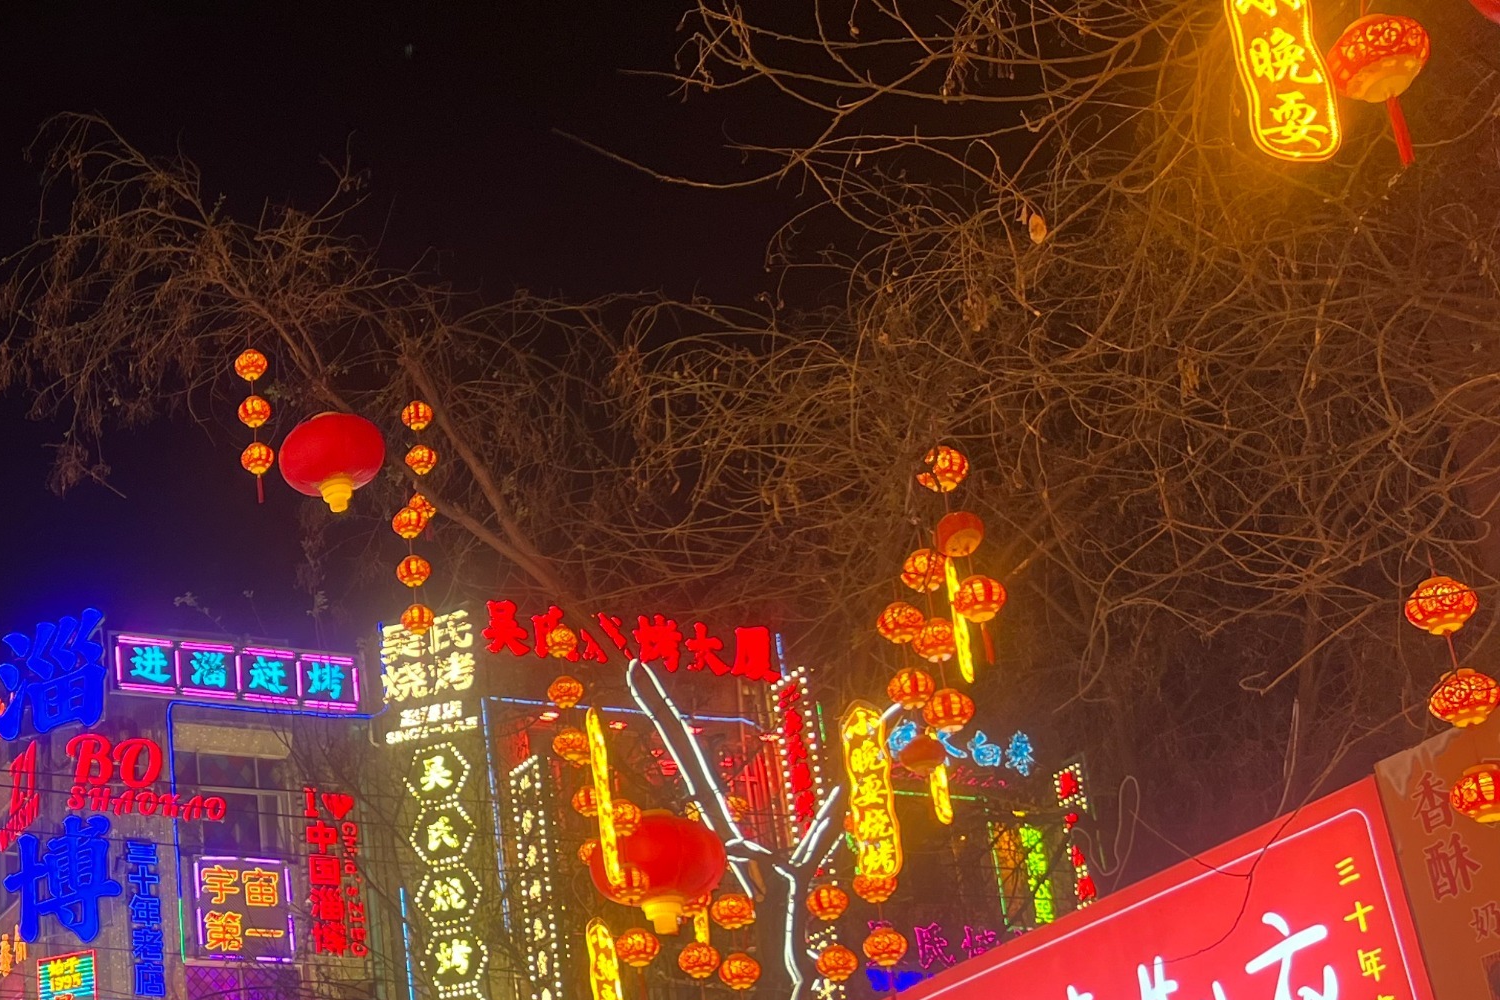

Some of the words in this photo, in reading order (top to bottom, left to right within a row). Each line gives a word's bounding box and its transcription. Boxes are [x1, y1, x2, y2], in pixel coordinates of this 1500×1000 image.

[130, 645, 345, 700] 进淄赶烤
[380, 652, 475, 703] 烧烤
[66, 734, 163, 790] BO
[1411, 772, 1481, 902] 香酥
[3, 815, 122, 944] 博
[200, 864, 279, 908] 宇宙
[305, 820, 347, 957] 中国淄博
[127, 841, 167, 998] 三十年老店
[202, 910, 284, 951] 第一
